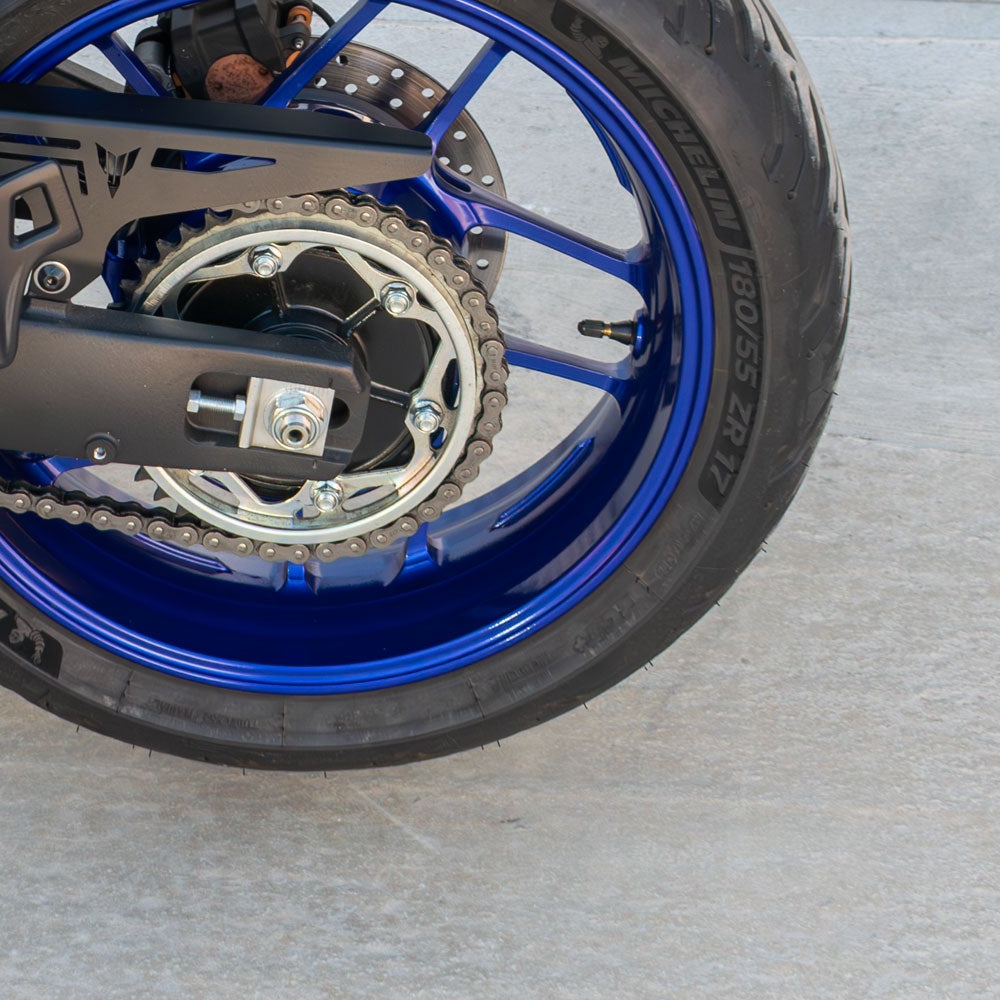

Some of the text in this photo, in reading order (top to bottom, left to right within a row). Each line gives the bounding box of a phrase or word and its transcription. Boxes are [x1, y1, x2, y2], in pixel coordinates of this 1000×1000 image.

[608, 55, 741, 232] MICHELIN
[710, 260, 760, 495] 180/55 ZR 17
